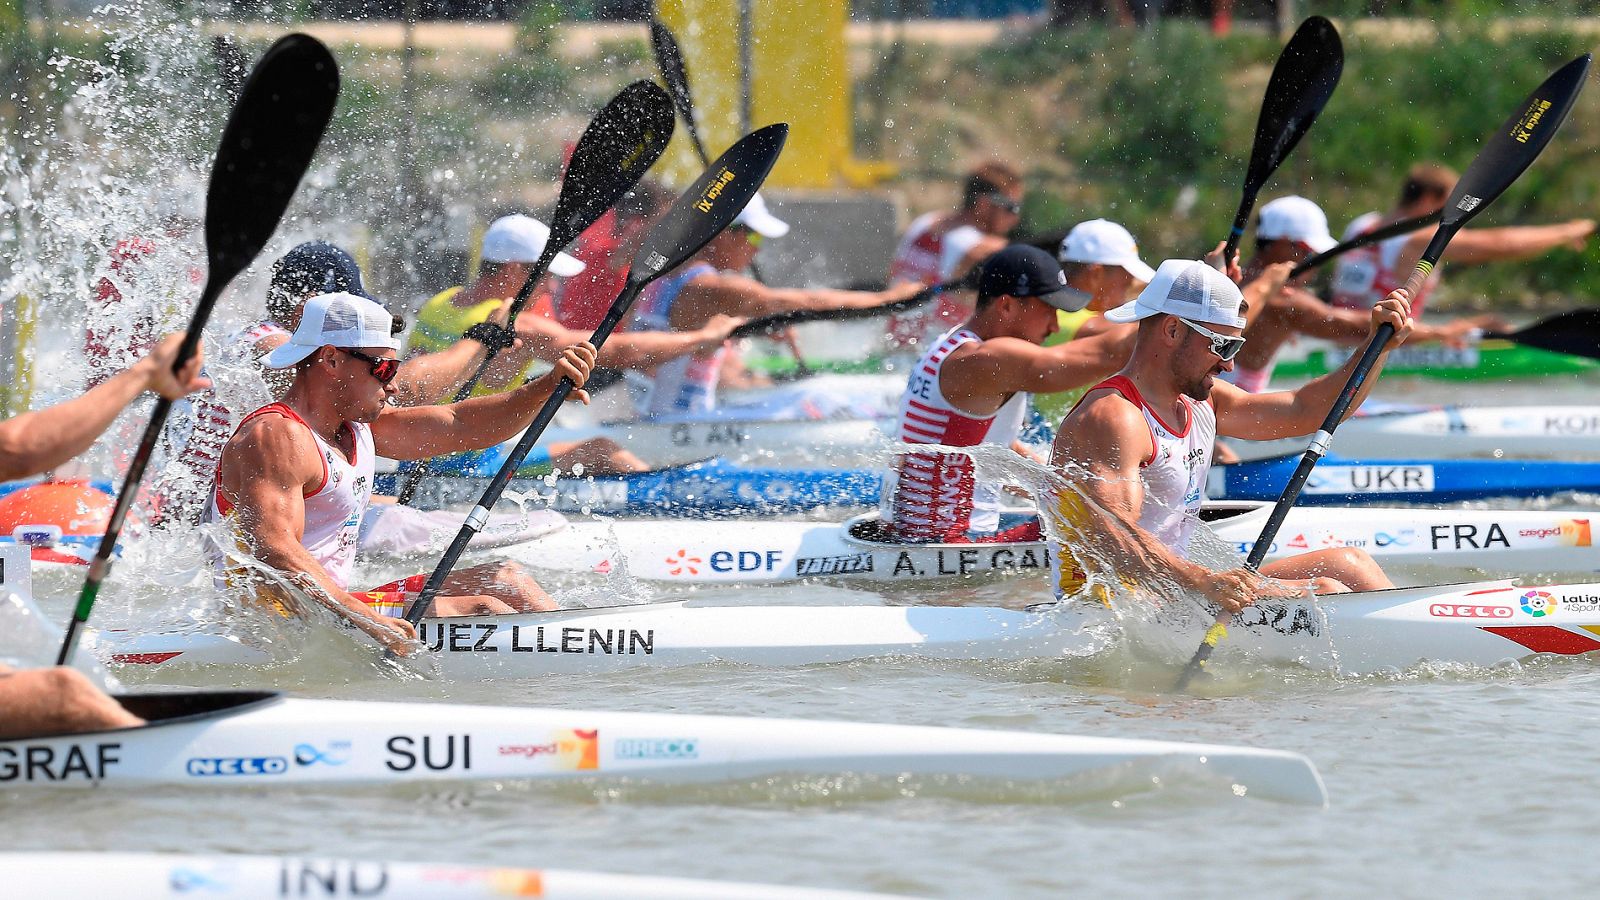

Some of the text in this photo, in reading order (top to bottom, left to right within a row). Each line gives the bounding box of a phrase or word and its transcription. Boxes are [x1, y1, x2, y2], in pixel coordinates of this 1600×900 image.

[1351, 467, 1425, 491] UKR
[1431, 523, 1511, 550] FRA
[1519, 527, 1561, 538] szeged
[893, 551, 924, 576] A.
[938, 549, 979, 575] LE
[1432, 604, 1511, 618] NELO
[1562, 594, 1600, 604] LaLig
[512, 625, 654, 655] LLENIN
[0, 744, 121, 781] GRAF
[385, 734, 470, 772] SUI
[279, 858, 389, 898] IND
